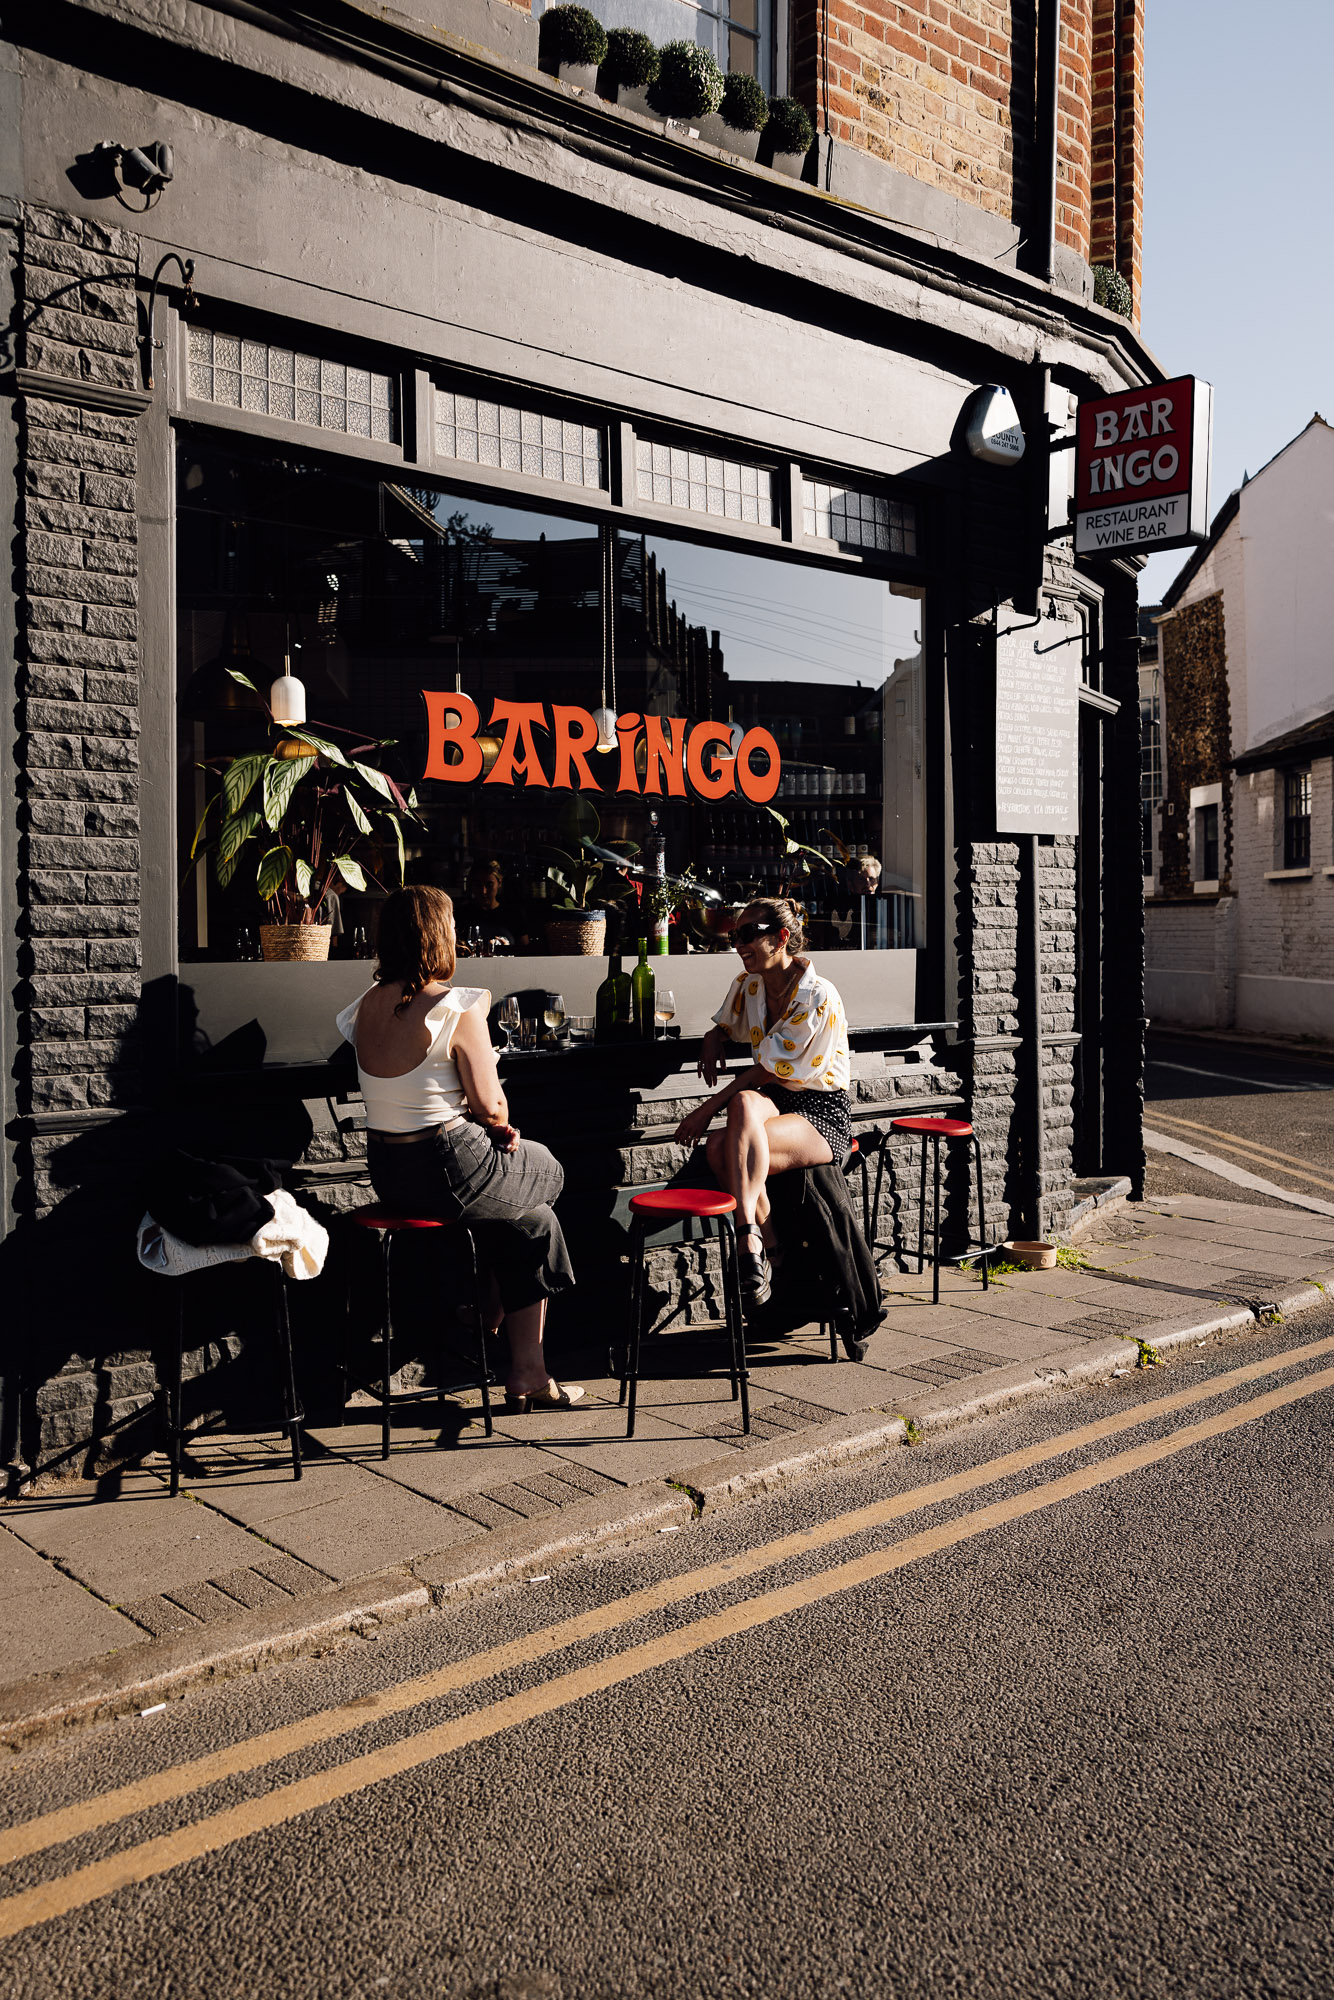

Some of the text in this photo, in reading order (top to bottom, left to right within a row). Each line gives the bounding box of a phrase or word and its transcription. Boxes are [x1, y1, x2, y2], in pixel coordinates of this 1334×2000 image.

[1094, 398, 1176, 448] BAR
[1086, 501, 1178, 530] RESTAURANT
[1096, 522, 1166, 546] WINE BAR
